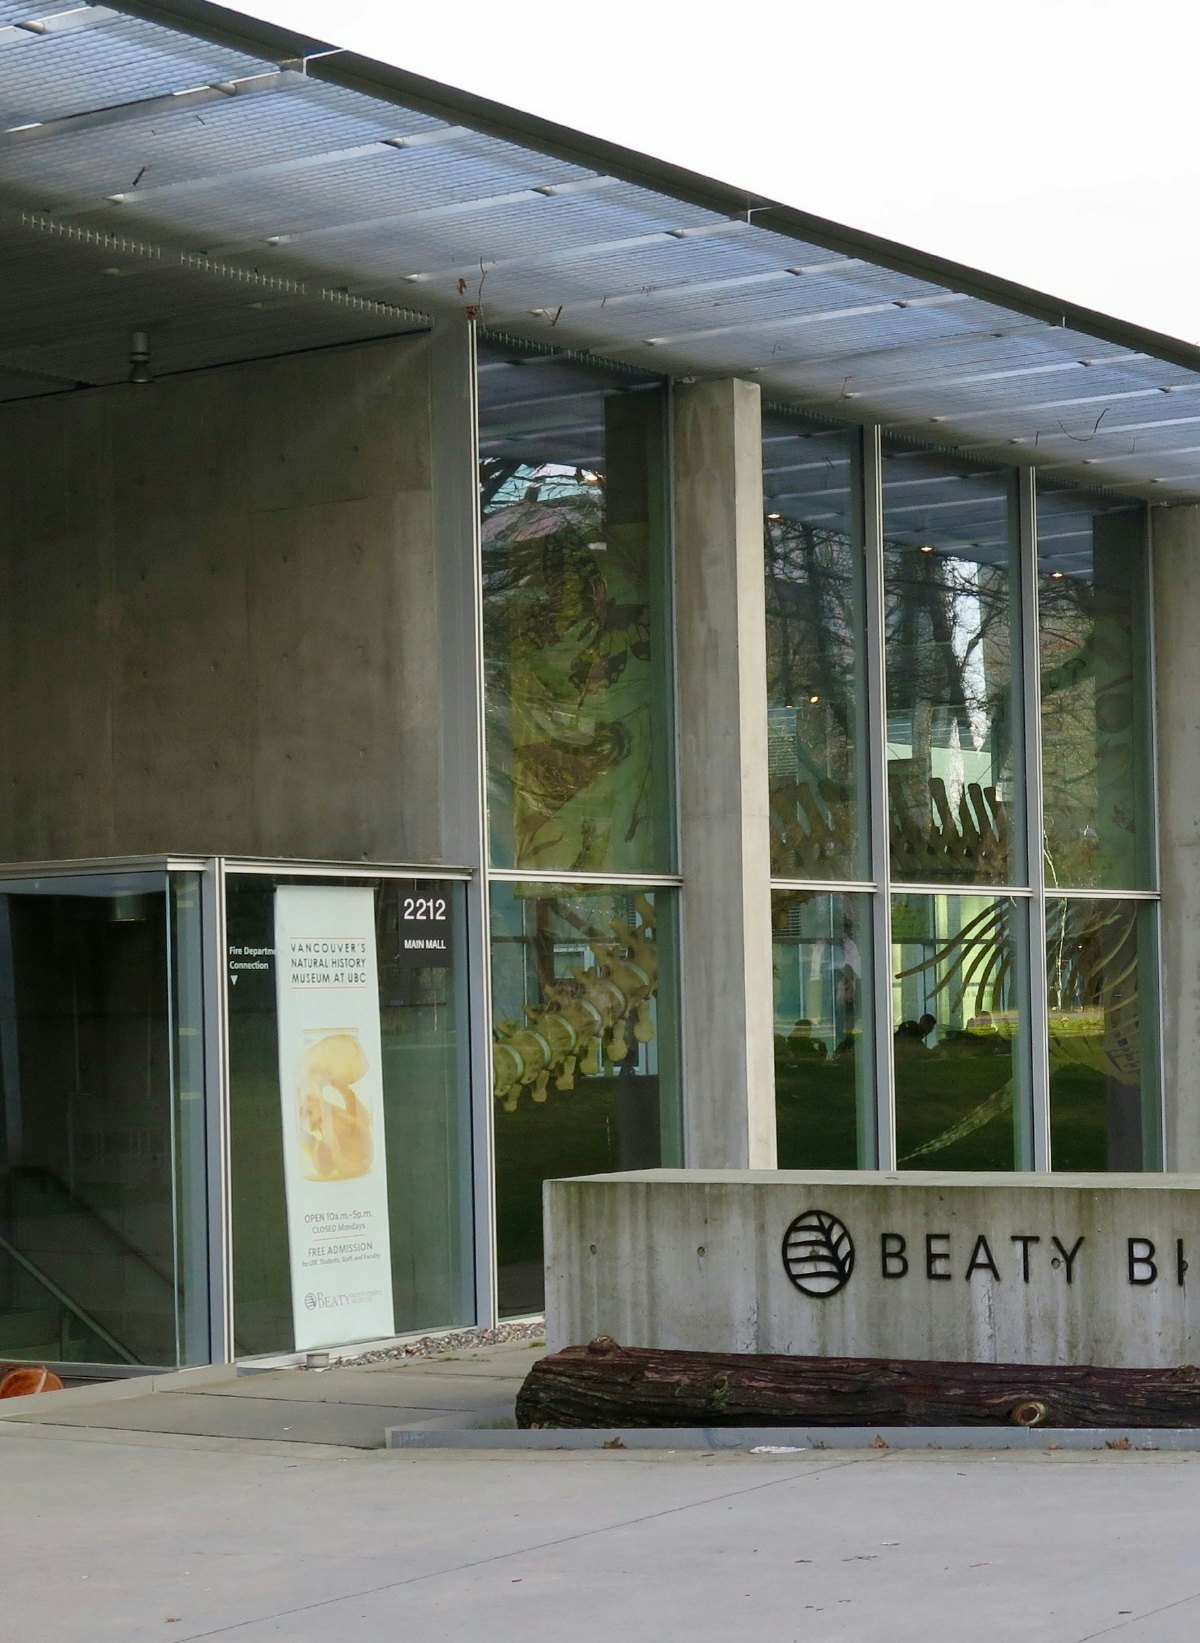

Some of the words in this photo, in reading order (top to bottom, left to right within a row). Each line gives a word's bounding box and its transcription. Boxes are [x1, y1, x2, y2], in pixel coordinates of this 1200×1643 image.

[403, 898, 446, 920] 2212
[290, 943, 366, 953] VANCOUVER'S
[404, 939, 424, 949] MAIN
[426, 939, 447, 949] MALL
[229, 946, 242, 955] Fire
[229, 960, 269, 969] Connection
[291, 958, 329, 968] NATURAL
[331, 958, 366, 968] HISTORY
[292, 973, 330, 983] MUSEUM
[334, 973, 345, 983] AT
[348, 972, 366, 983] UBC
[304, 1212, 325, 1224] OPEN
[312, 1224, 337, 1234] CLOSED
[338, 1222, 366, 1232] Mondays
[308, 1246, 326, 1257] FREE
[327, 1242, 374, 1254] ADMISSION
[880, 1232, 1085, 1283] BEATY
